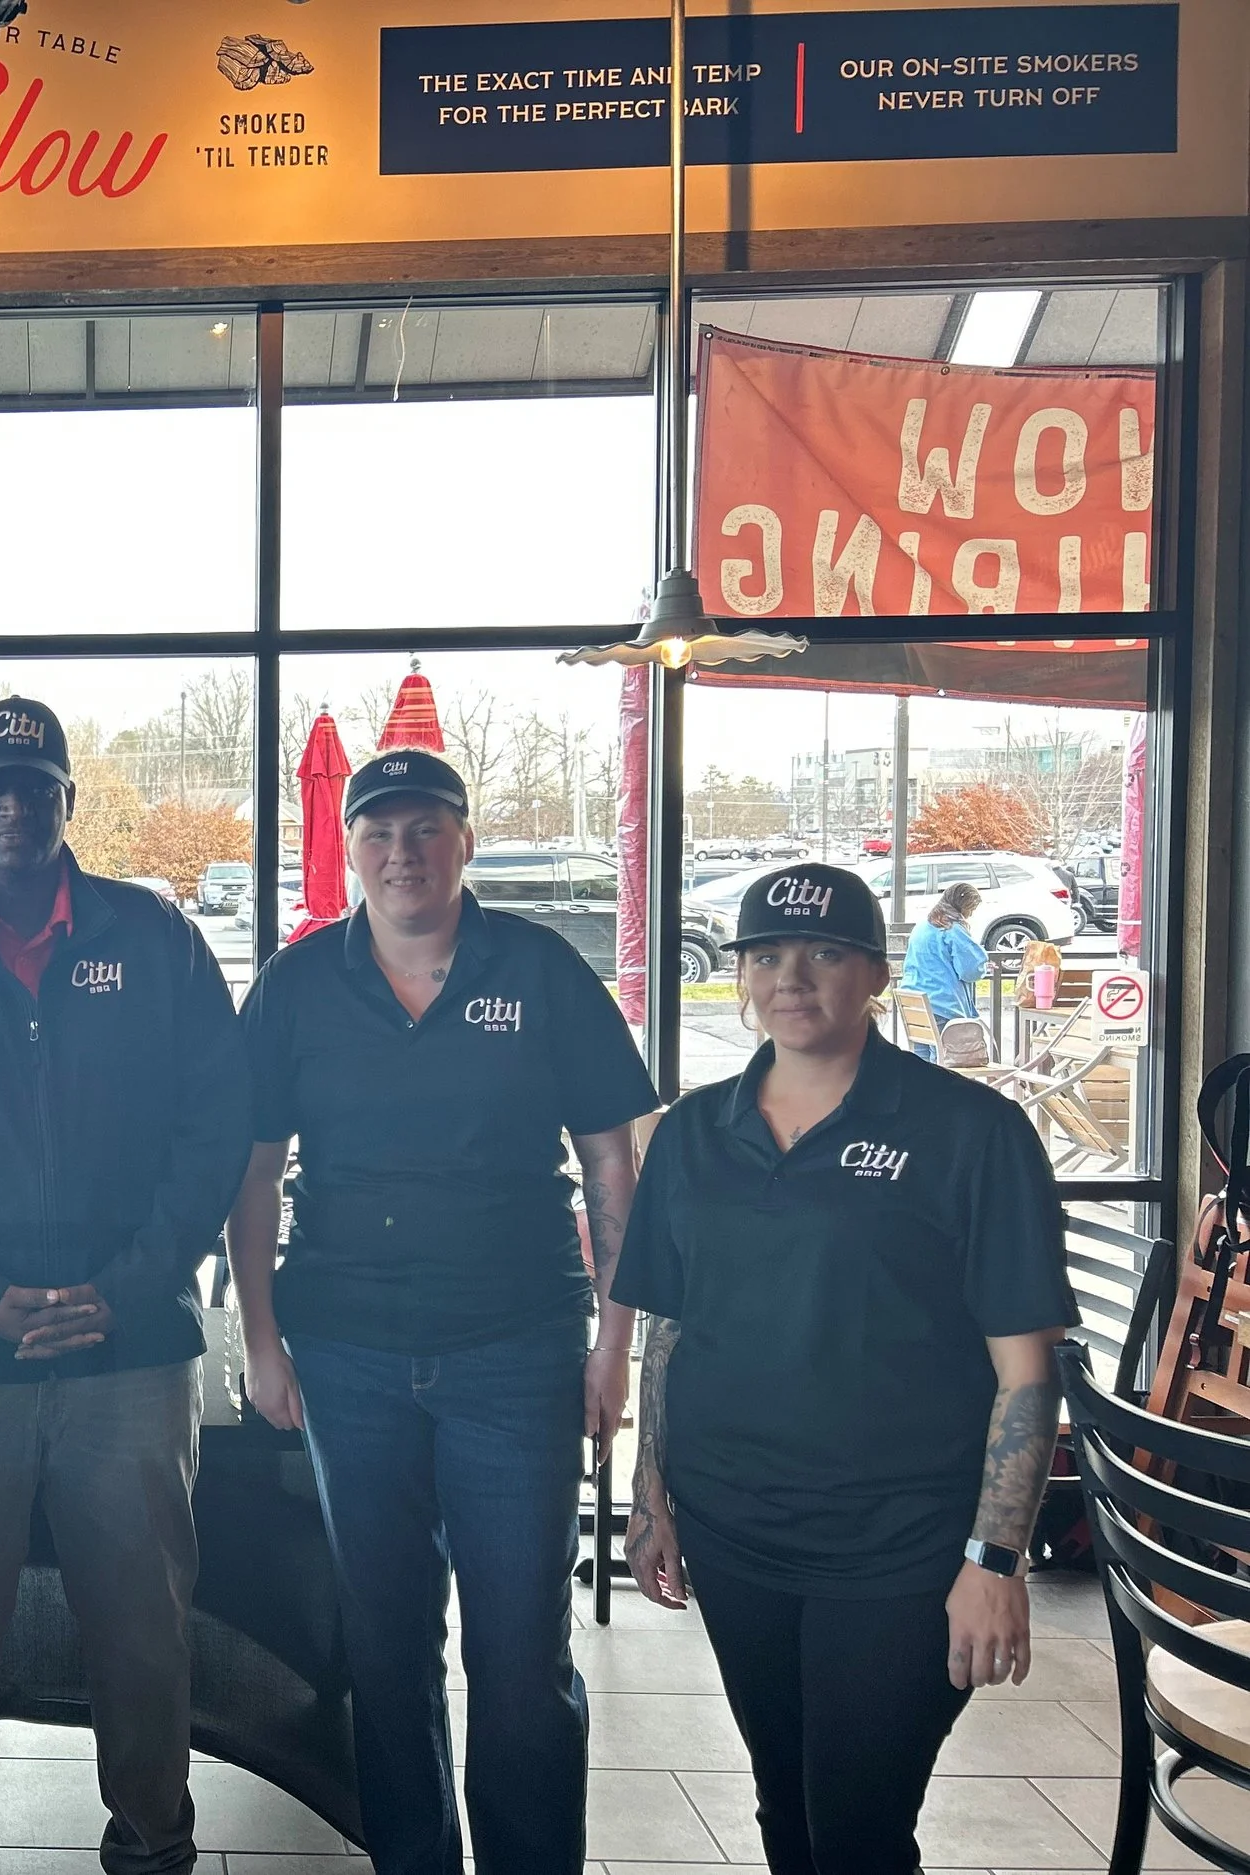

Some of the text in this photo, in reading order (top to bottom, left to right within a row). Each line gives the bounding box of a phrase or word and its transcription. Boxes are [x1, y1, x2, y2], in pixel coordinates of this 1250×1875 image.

[37, 30, 122, 64] TABLE
[418, 63, 762, 93] THE EXACT TIME AN TEMP
[840, 53, 1139, 79] OUR ON-SITE SMOKERS
[438, 106, 487, 126] FOR
[497, 104, 547, 124] THE
[555, 99, 666, 122] PERFECT
[878, 87, 1100, 111] NEVER TURN OFF
[220, 113, 305, 135] SMOKED
[196, 145, 329, 168] 'TIL TENDER
[382, 761, 409, 775] City
[767, 876, 833, 918] City
[784, 907, 811, 916] BBQ
[71, 960, 123, 991] City
[465, 997, 522, 1032] City
[840, 1140, 909, 1181] City
